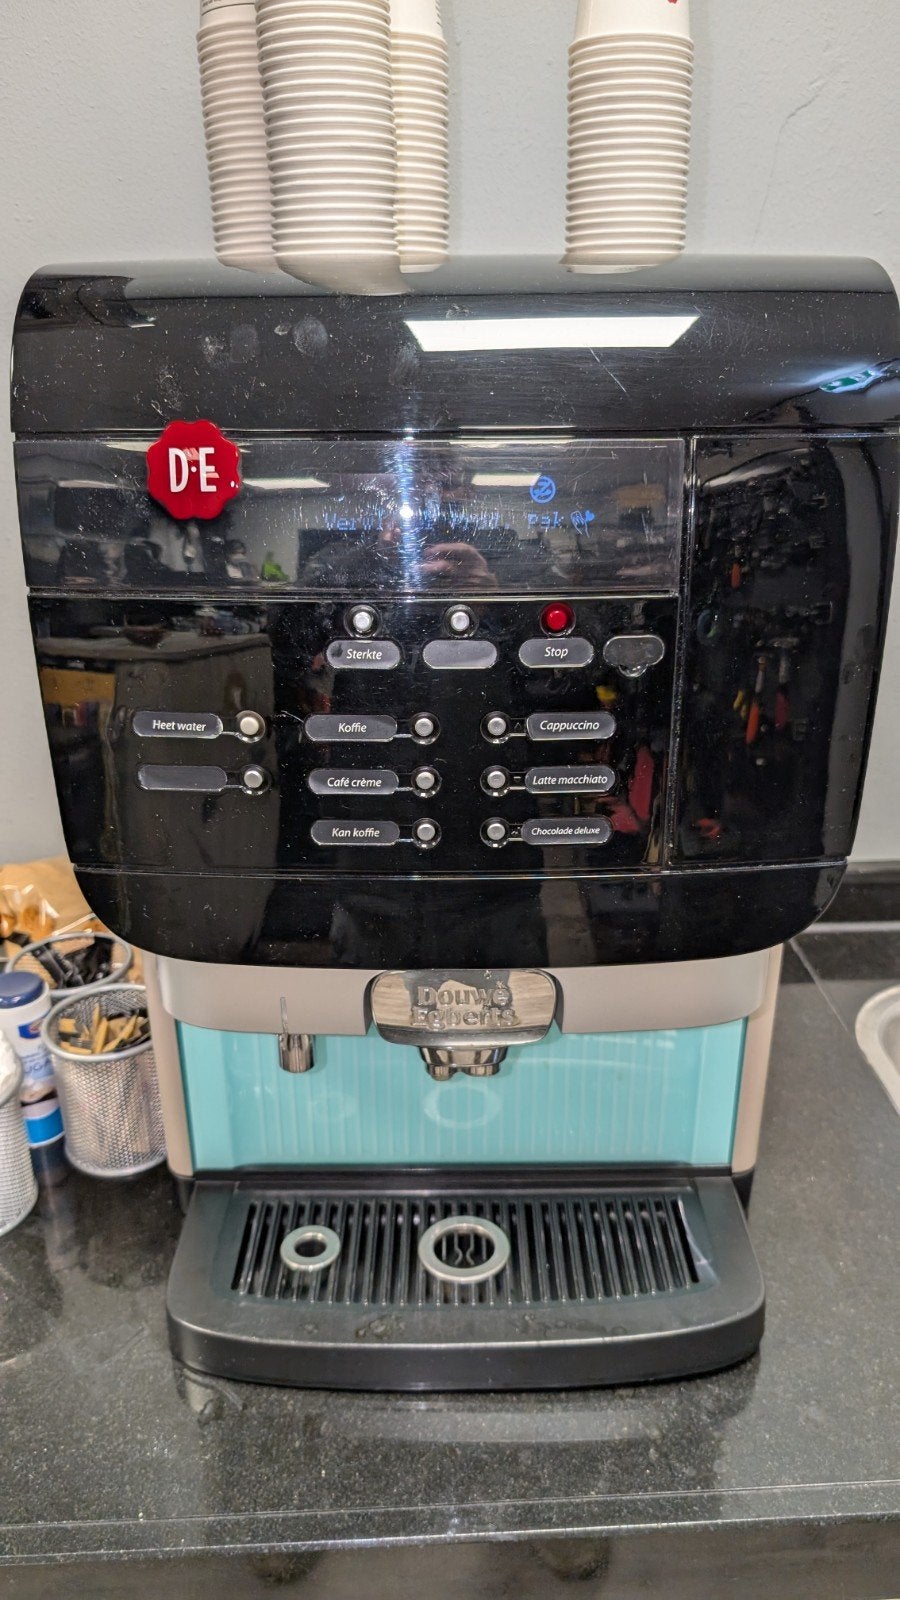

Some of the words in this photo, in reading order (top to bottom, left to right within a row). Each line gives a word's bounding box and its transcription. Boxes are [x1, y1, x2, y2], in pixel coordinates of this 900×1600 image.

[527, 511, 564, 530] Pak
[346, 646, 382, 661] Sterkte
[545, 645, 569, 660] Stop
[152, 719, 176, 732] Heet
[177, 721, 207, 733] water
[338, 721, 367, 734] Koffie
[539, 719, 600, 733] Cappuccino
[327, 775, 350, 789] Café
[351, 775, 382, 788] crème
[532, 773, 556, 786] Latte
[557, 773, 608, 786] macchiato
[331, 826, 349, 839] Kan
[350, 825, 380, 839] koffie
[531, 825, 573, 836] Chocolade
[573, 825, 601, 836] deluxe
[417, 985, 513, 1007] Douwe
[411, 1006, 515, 1031] Egberts
